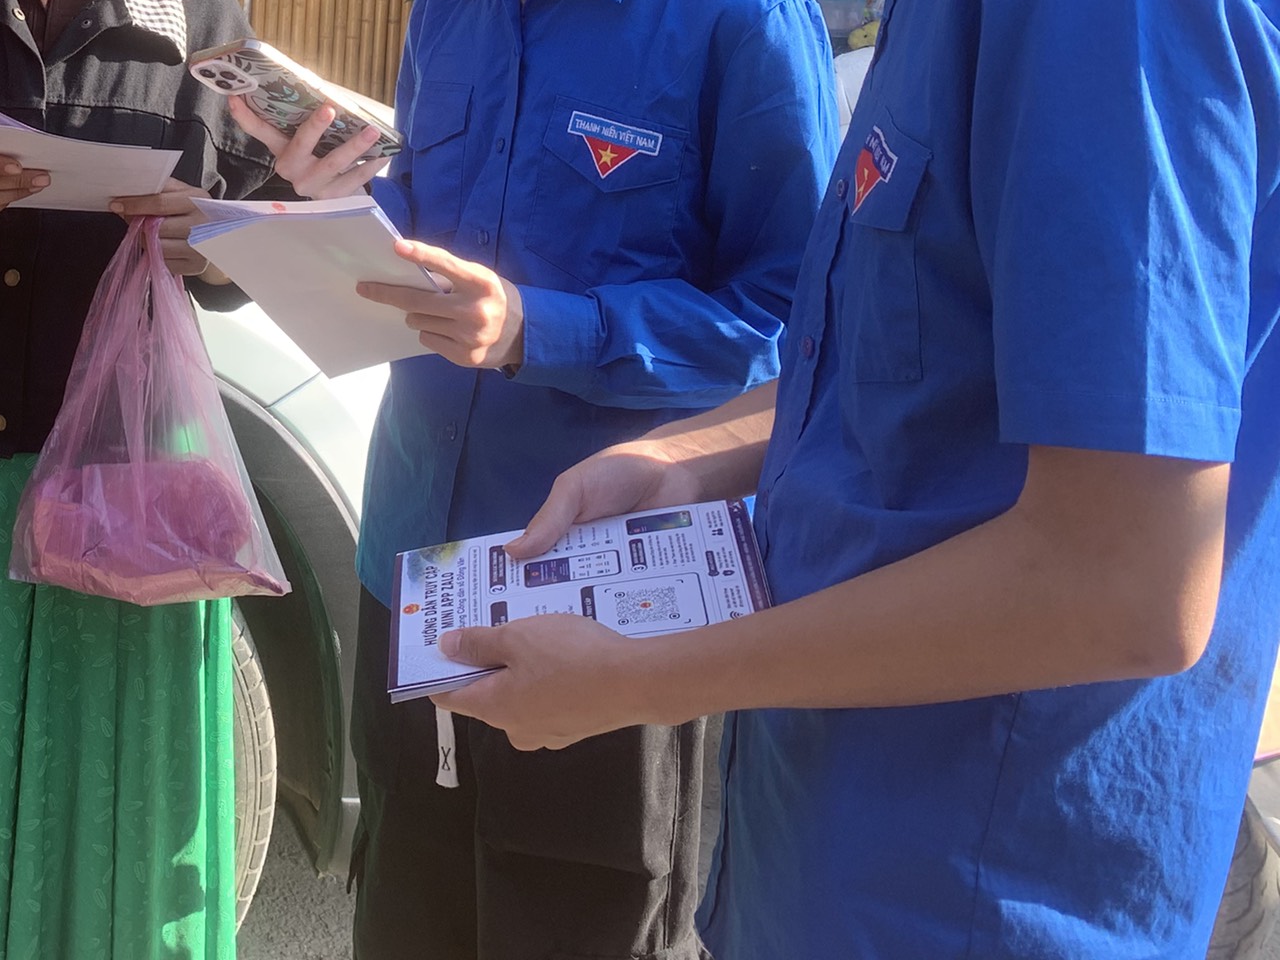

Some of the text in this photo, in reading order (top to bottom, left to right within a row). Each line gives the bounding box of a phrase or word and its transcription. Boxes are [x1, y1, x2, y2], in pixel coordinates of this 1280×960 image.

[575, 119, 600, 132] THANH
[618, 130, 634, 145] VIỆT
[636, 136, 655, 148] NAM
[421, 565, 440, 646] HƯỚNG DẪN TRUY CẬP
[441, 572, 454, 629] MINI APP ZALO
